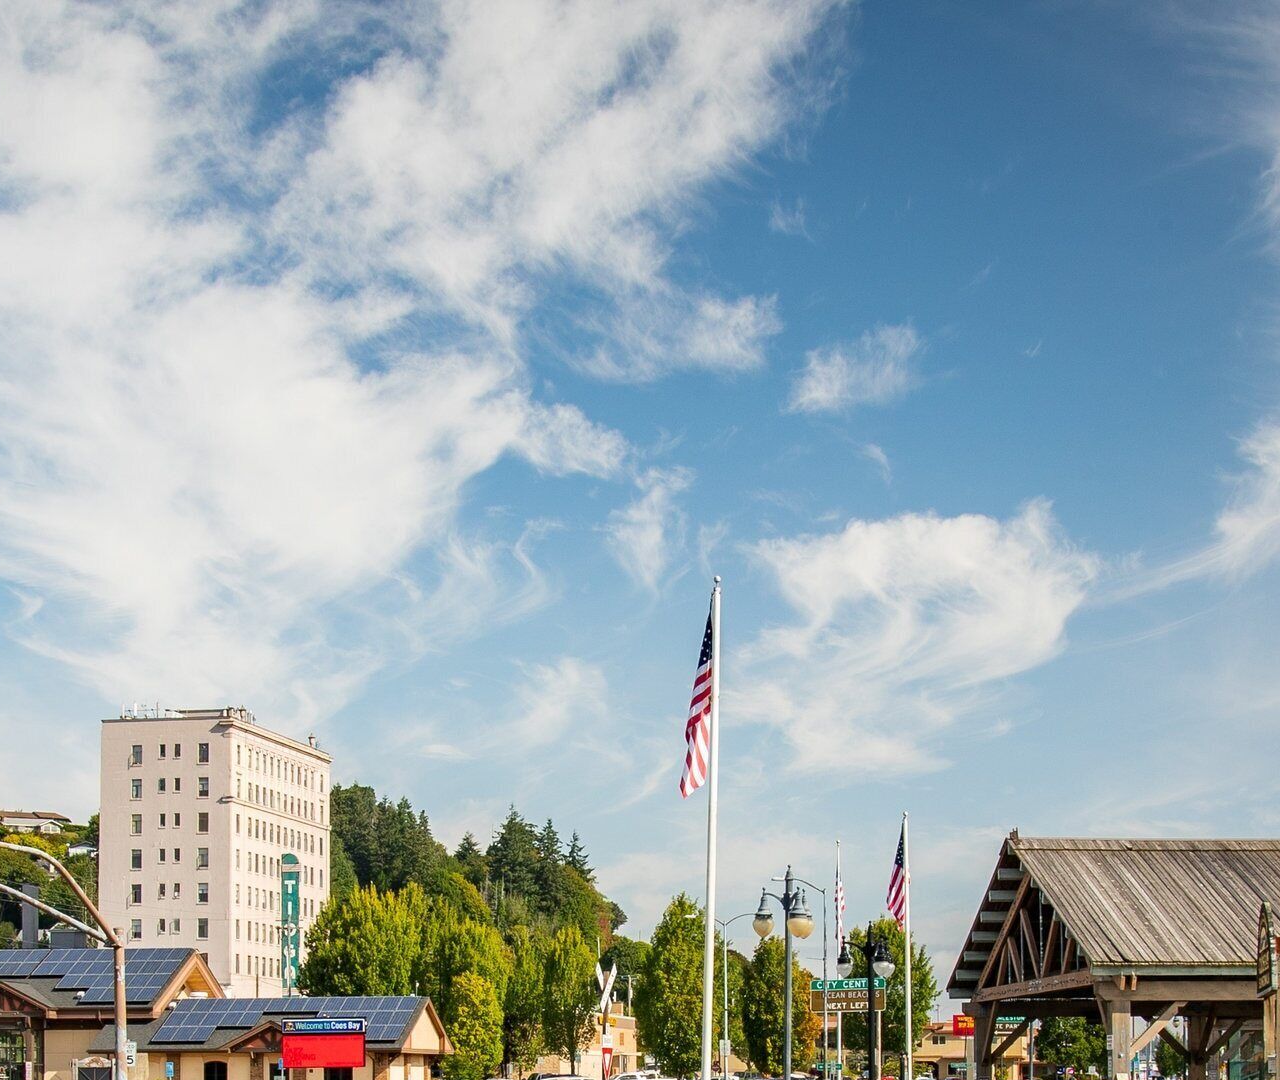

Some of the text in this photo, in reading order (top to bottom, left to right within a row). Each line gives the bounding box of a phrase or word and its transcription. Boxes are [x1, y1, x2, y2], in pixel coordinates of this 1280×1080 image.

[816, 980, 880, 989] CTY CENTR
[826, 1001, 869, 1010] NEXT LEFT
[295, 1021, 361, 1031] Welcome to Coos Bay
[125, 1054, 134, 1065] 5
